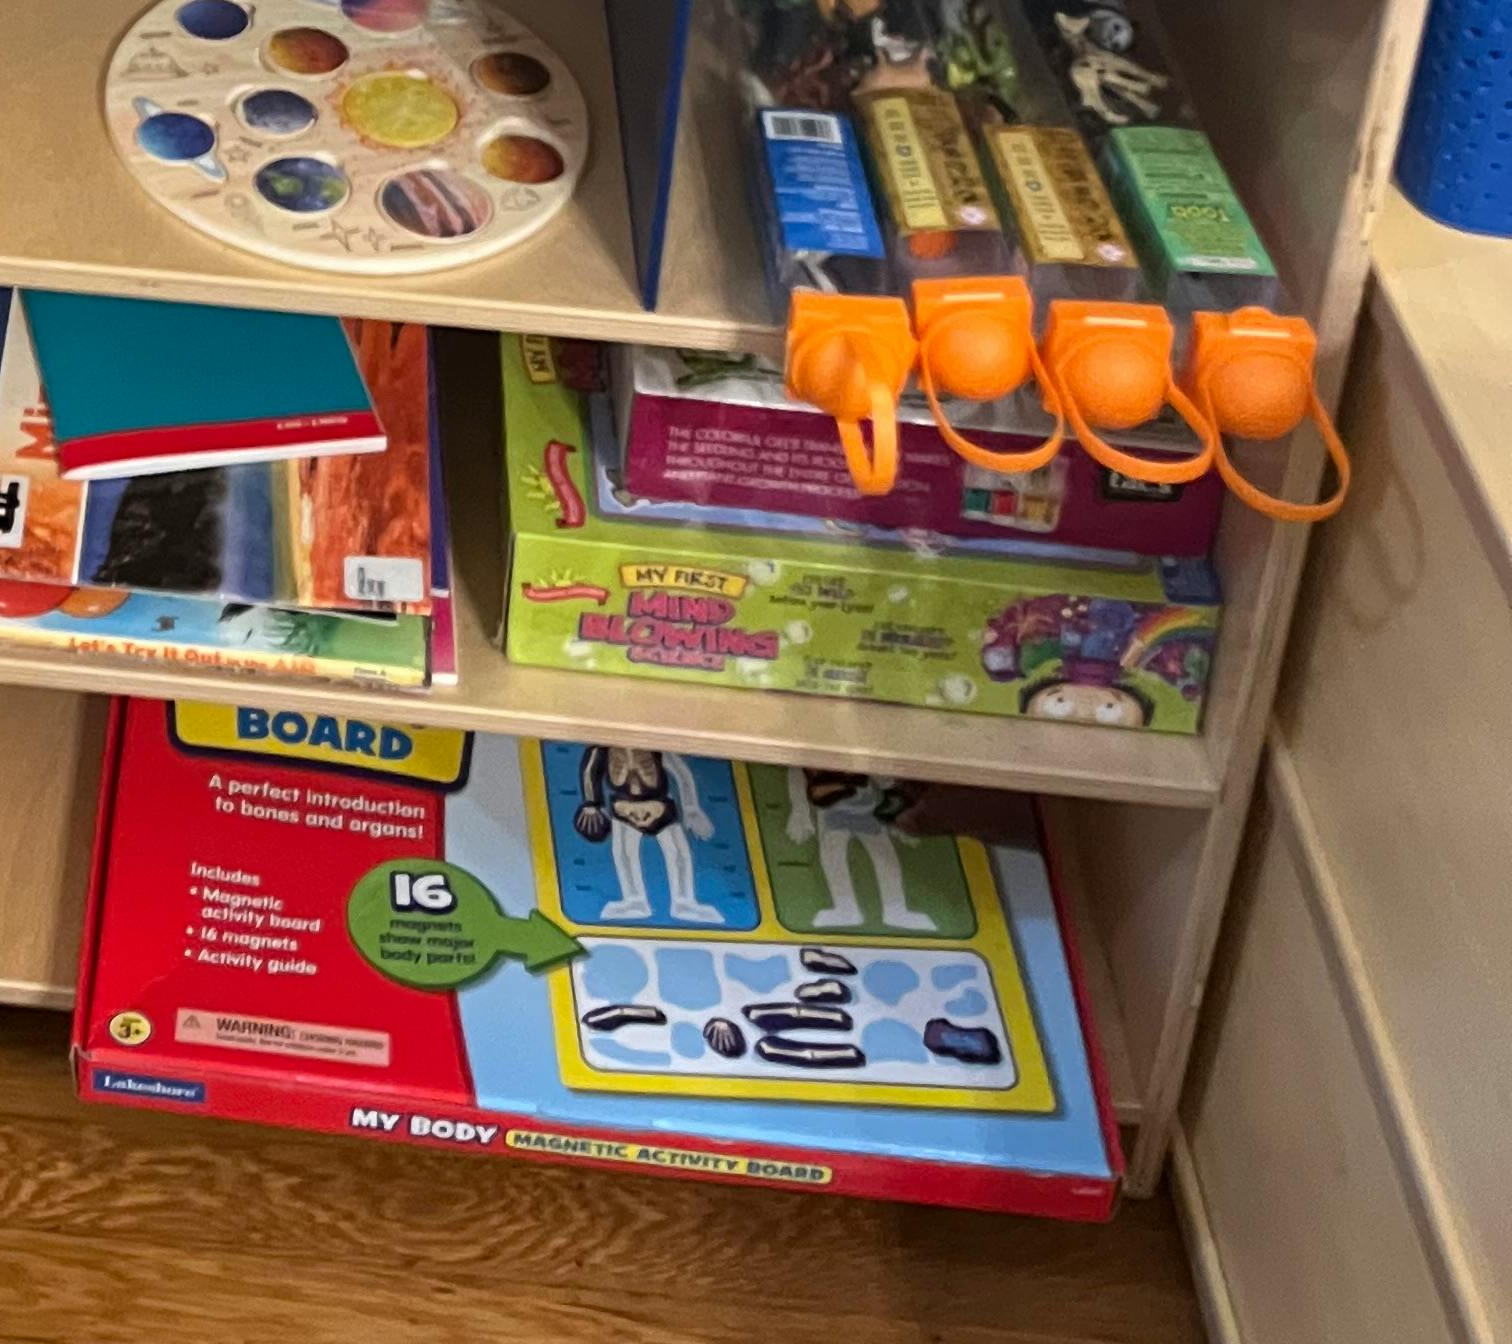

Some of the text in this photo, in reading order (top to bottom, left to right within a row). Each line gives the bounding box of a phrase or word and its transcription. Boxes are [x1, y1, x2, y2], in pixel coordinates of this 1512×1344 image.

[634, 567, 727, 590] MY FIRST
[627, 591, 736, 626] MIND
[579, 611, 780, 660] BLOWING
[237, 707, 413, 760] BOARD
[209, 773, 425, 820] A perfect introduction
[215, 796, 424, 840] to bones and organs!
[202, 886, 283, 911] Magnetic
[392, 872, 455, 911] 16
[201, 906, 321, 933] activity board
[390, 919, 463, 934] magnets
[200, 926, 299, 952] 16 magnets
[379, 932, 476, 951] show major
[197, 948, 318, 976] Activity guide
[379, 949, 422, 964] body
[118, 1023, 141, 1039] 3+
[351, 1108, 825, 1182] MY BODY MAGNETIC ACTIVITY BOARD
